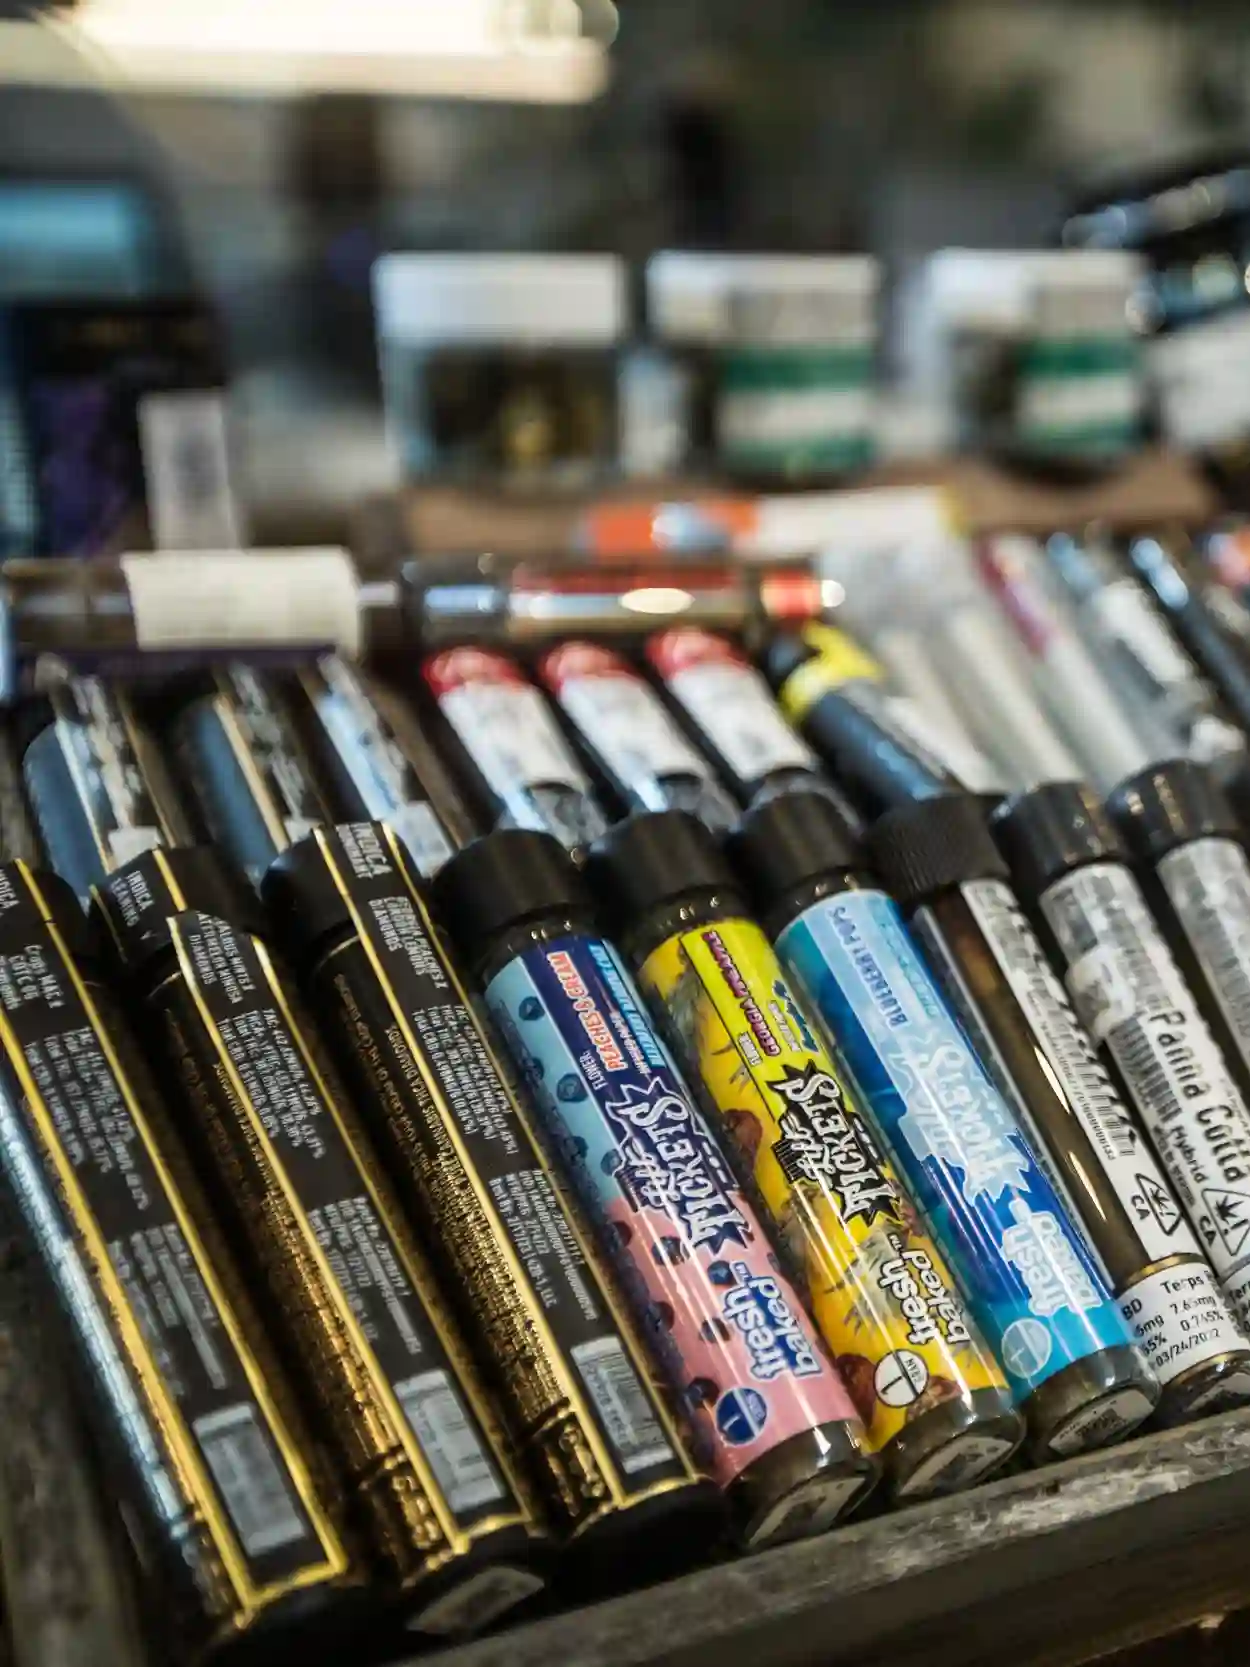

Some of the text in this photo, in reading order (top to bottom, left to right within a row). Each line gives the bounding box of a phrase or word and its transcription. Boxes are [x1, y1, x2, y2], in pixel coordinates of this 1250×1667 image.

[352, 822, 390, 874] INDICA
[126, 871, 156, 912] INDICA
[197, 913, 229, 971] ATERMELON
[369, 899, 401, 950] DIAMONDS
[189, 934, 216, 984] DIAMONDS
[547, 951, 587, 998] CREAM
[829, 906, 906, 1025] BLUEBERRY POPS
[412, 1009, 431, 1032] Total
[427, 1006, 443, 1027] Total
[580, 1010, 626, 1070] PEACHES
[739, 997, 781, 1056] GEORGIA
[385, 1025, 420, 1078] DIAMONDS
[1150, 1011, 1205, 1098] Panna
[410, 1077, 429, 1105] THCA
[908, 1039, 1027, 1189] TICKETS
[422, 1105, 454, 1156] CANNABIS
[773, 1064, 898, 1220] TICKETS
[1168, 1125, 1207, 1182] Hybrid
[620, 1090, 752, 1245] TICKETS
[1130, 1194, 1150, 1220] CA
[1198, 1215, 1216, 1246] CA
[898, 1244, 973, 1347] baked
[995, 1223, 1069, 1316] fresh
[745, 1272, 823, 1379] baked
[869, 1256, 944, 1348] fresh
[1120, 1298, 1142, 1320] BD
[712, 1284, 793, 1380] fresh
